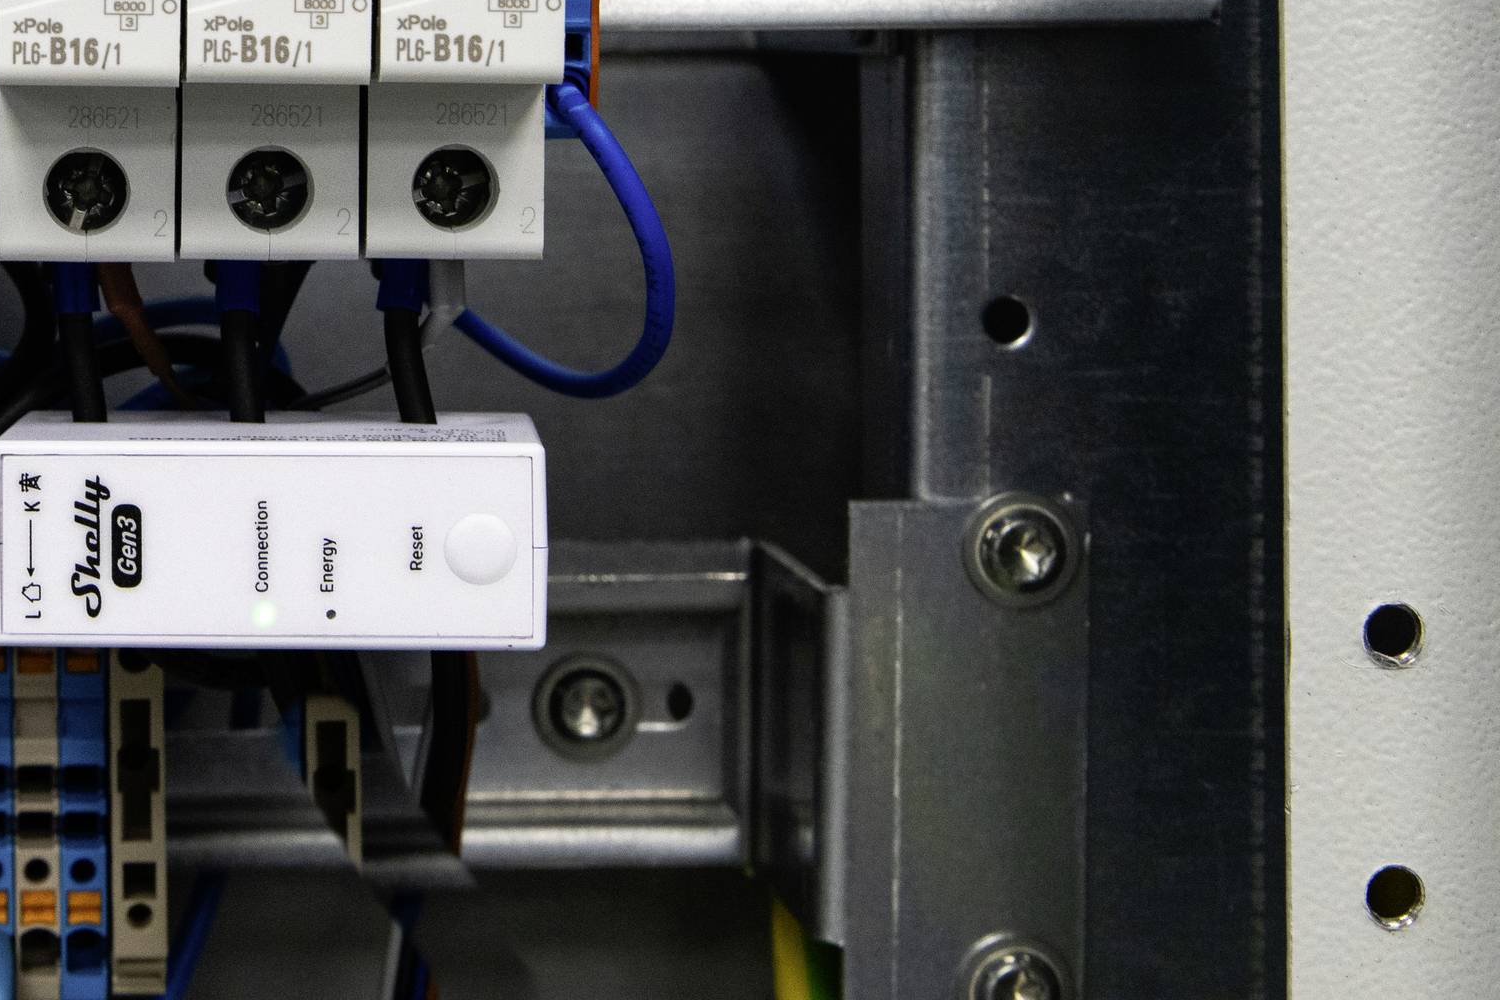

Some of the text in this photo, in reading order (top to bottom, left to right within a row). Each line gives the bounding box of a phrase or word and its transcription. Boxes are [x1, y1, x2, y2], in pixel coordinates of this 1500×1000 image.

[113, 1, 146, 12] 6000
[303, 0, 336, 10] 6000
[509, 14, 518, 24] 3
[12, 18, 64, 34] xPole
[125, 18, 134, 28] 3
[203, 16, 254, 32] xPole
[316, 15, 325, 26] 3
[396, 15, 448, 31] xPole
[153, 209, 169, 238] 2
[336, 207, 351, 236] 2
[521, 206, 536, 235] 2
[24, 500, 42, 619] L K
[70, 475, 111, 618] Shelly
[116, 515, 137, 576] Gen3
[254, 500, 269, 593] Connection
[409, 525, 424, 572] Reset
[320, 537, 338, 593] Energy
